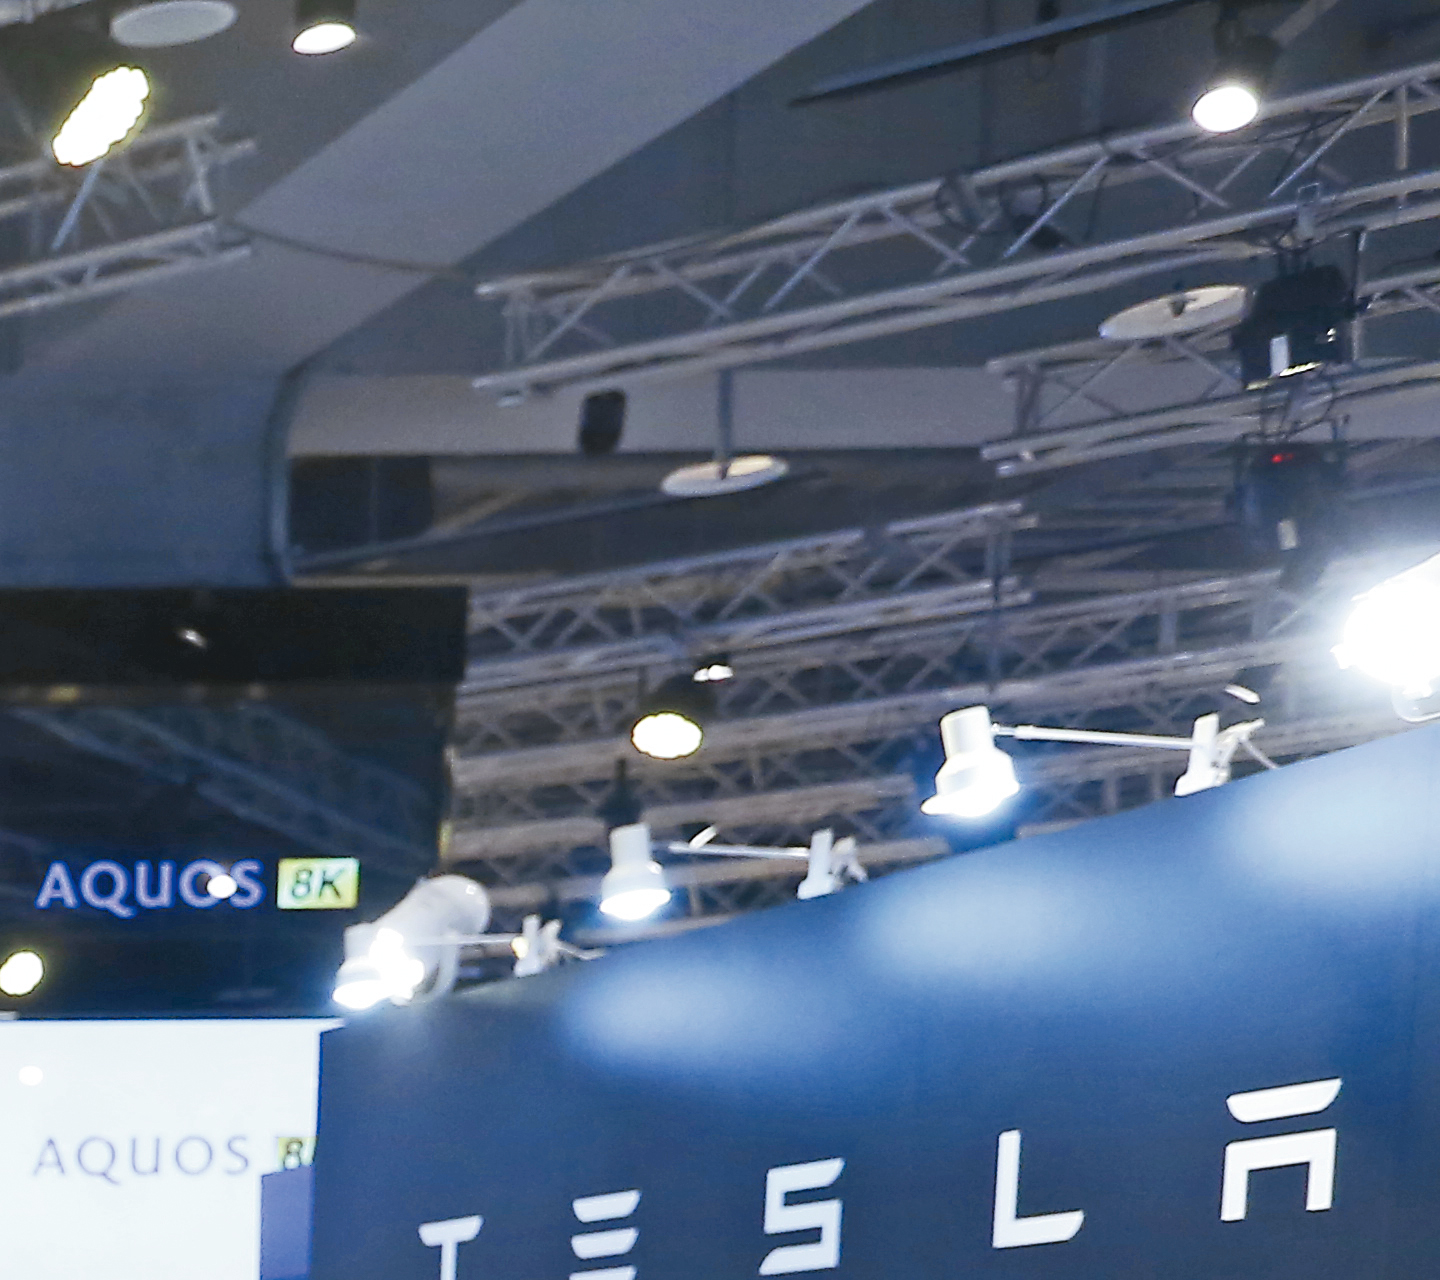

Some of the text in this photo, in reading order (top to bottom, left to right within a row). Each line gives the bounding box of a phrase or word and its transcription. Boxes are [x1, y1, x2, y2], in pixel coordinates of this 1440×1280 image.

[33, 859, 345, 918] AQUOS 8K
[33, 1135, 250, 1186] AQUOS
